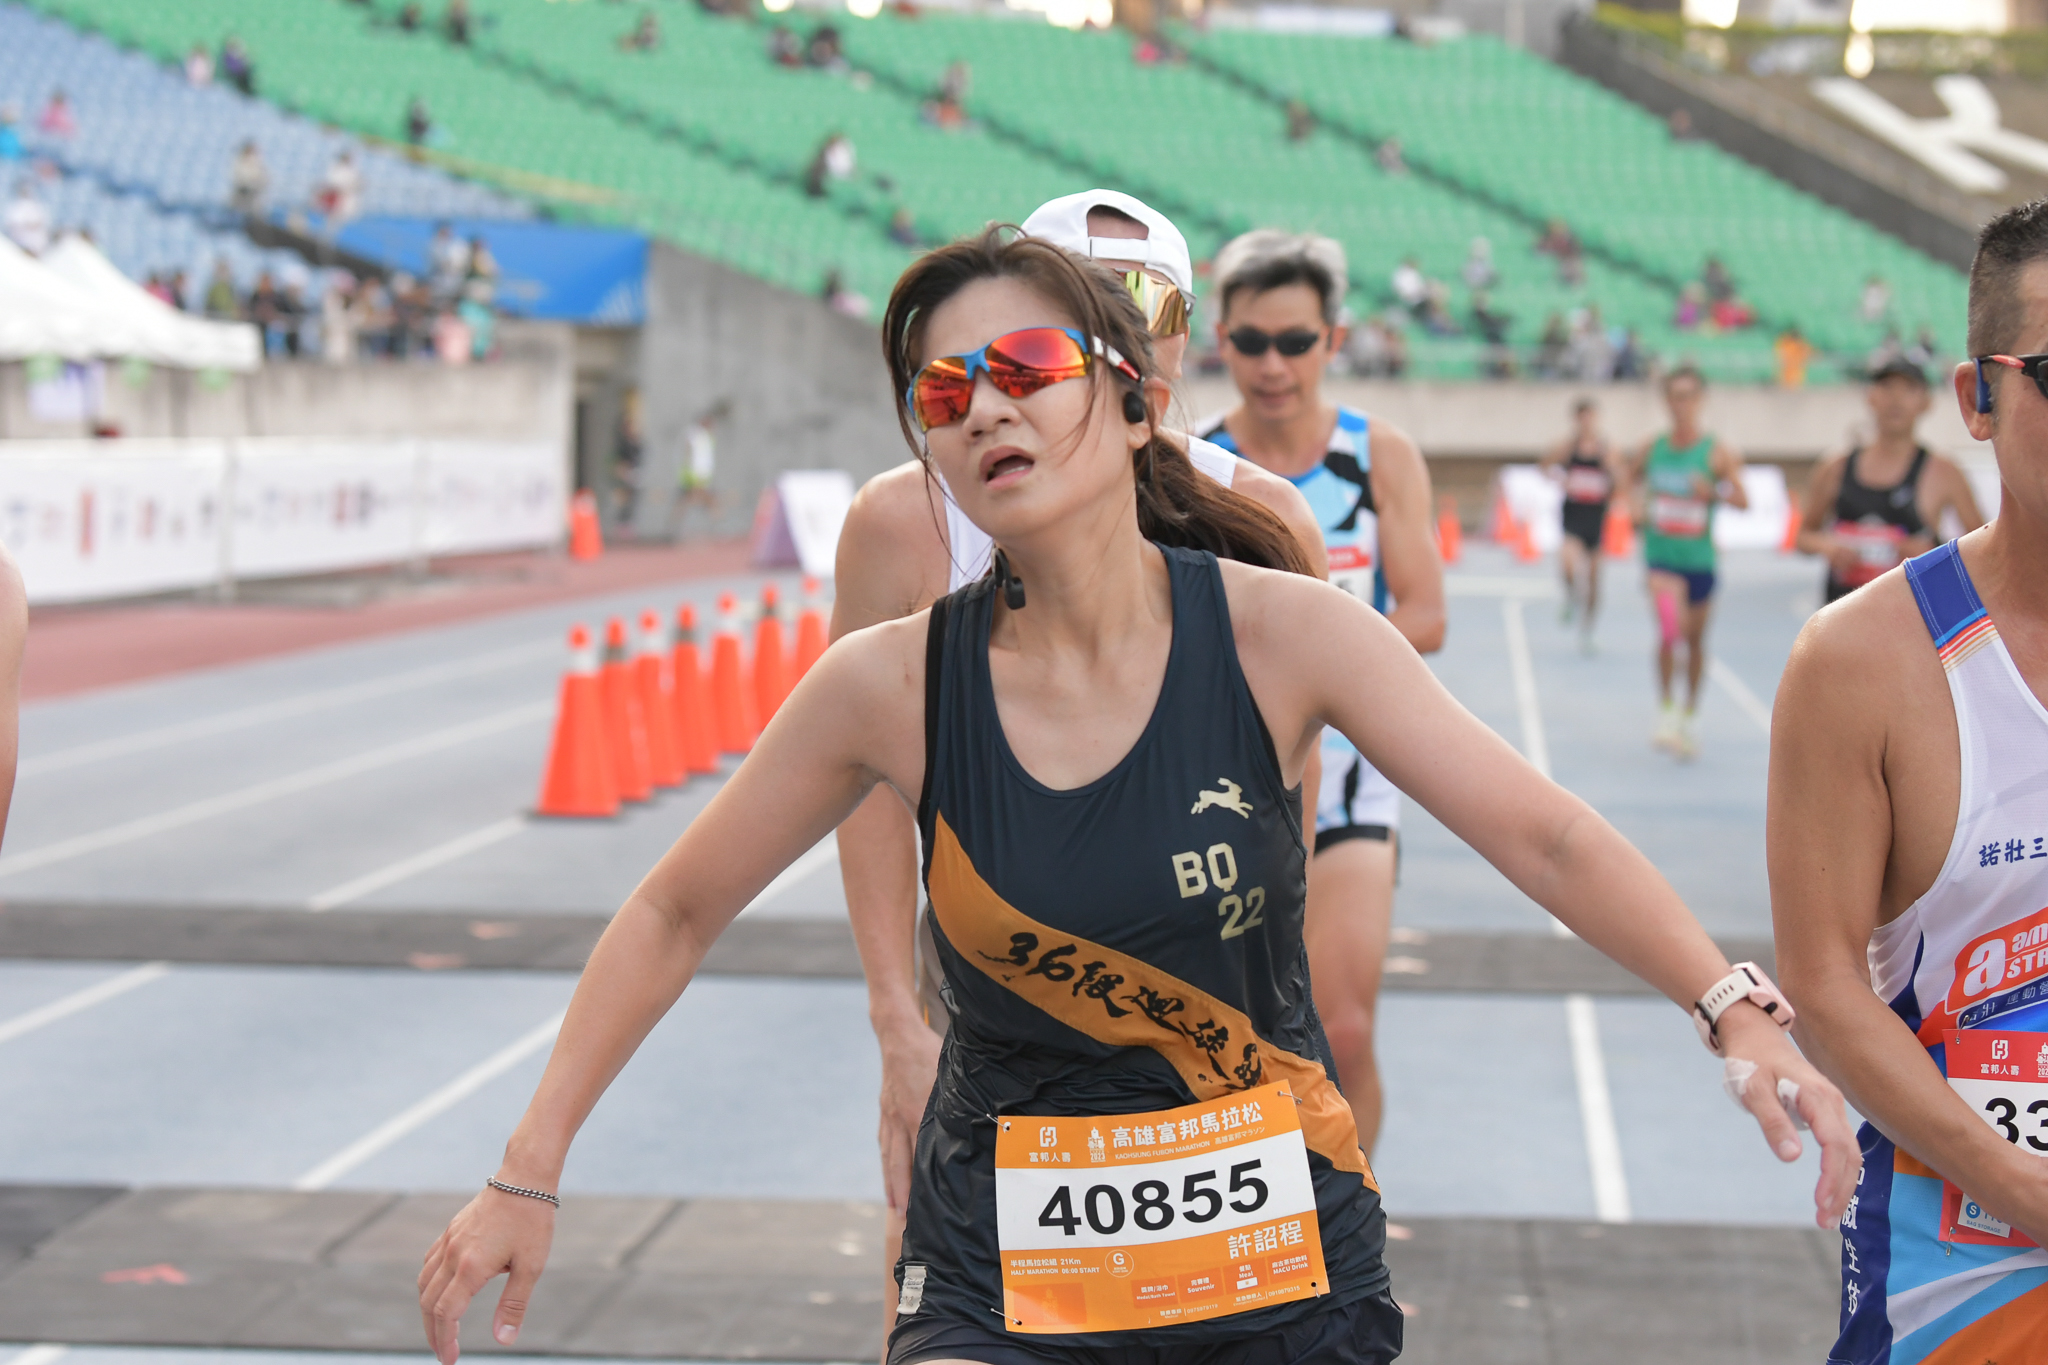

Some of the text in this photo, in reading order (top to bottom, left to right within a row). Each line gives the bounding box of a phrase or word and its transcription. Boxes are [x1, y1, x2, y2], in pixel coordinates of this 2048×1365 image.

[1979, 837, 2047, 868] 諾壯三
[1171, 842, 1239, 899] BQ
[1218, 886, 1266, 941] 22
[1963, 938, 2006, 997] a
[1980, 1063, 2020, 1076] 富邦人壽
[1111, 1101, 1263, 1149] 高雄富邦馬拉松
[1115, 1140, 1211, 1160] KAOHSIUNG FUBON MARATHON
[1028, 1152, 1071, 1163] 富邦人壽
[1038, 1158, 1269, 1236] 40855
[1969, 1204, 1977, 1216] S
[1978, 1223, 2001, 1233] STORAGE
[1227, 1220, 1304, 1260] 許詔程
[1060, 1258, 1081, 1266] 21Km
[1113, 1252, 1125, 1265] G
[1238, 1271, 1254, 1279] Meal
[1273, 1261, 1309, 1275] MACU Drink
[1187, 1283, 1215, 1294] Souvenir
